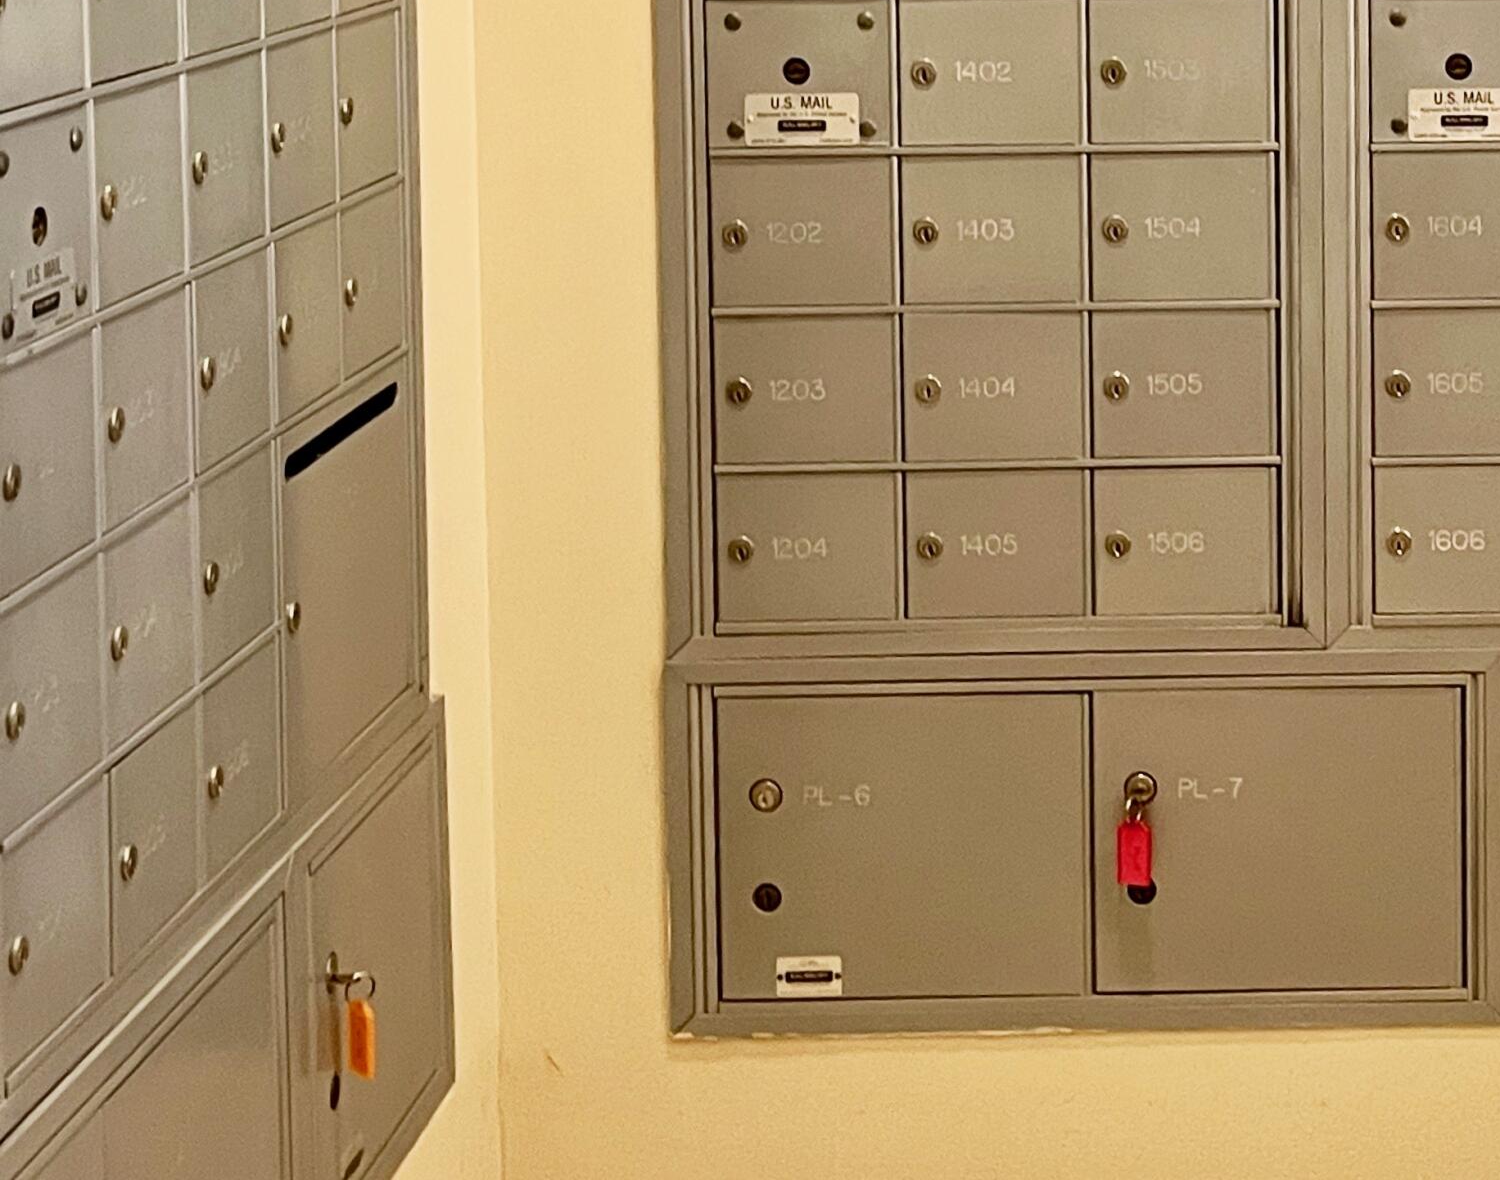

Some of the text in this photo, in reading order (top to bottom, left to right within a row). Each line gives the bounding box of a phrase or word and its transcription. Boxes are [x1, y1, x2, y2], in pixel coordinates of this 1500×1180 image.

[954, 60, 1013, 85] 1402
[800, 95, 833, 110] MAIL
[1463, 90, 1495, 105] MAIL
[766, 221, 823, 246] 1202
[956, 219, 1016, 243] 1403
[1144, 217, 1201, 240] 1504
[1426, 215, 1483, 237] 1604
[768, 378, 826, 403] 1203
[957, 376, 1016, 399] 1404
[1146, 374, 1203, 396] 1505
[1426, 372, 1483, 395] 1605
[772, 537, 828, 560] 1204
[960, 534, 1018, 557] 1405
[1147, 532, 1206, 555] 1506
[1427, 529, 1486, 552] 1606
[801, 784, 871, 809] PL-6
[1177, 777, 1243, 802] PL-7
